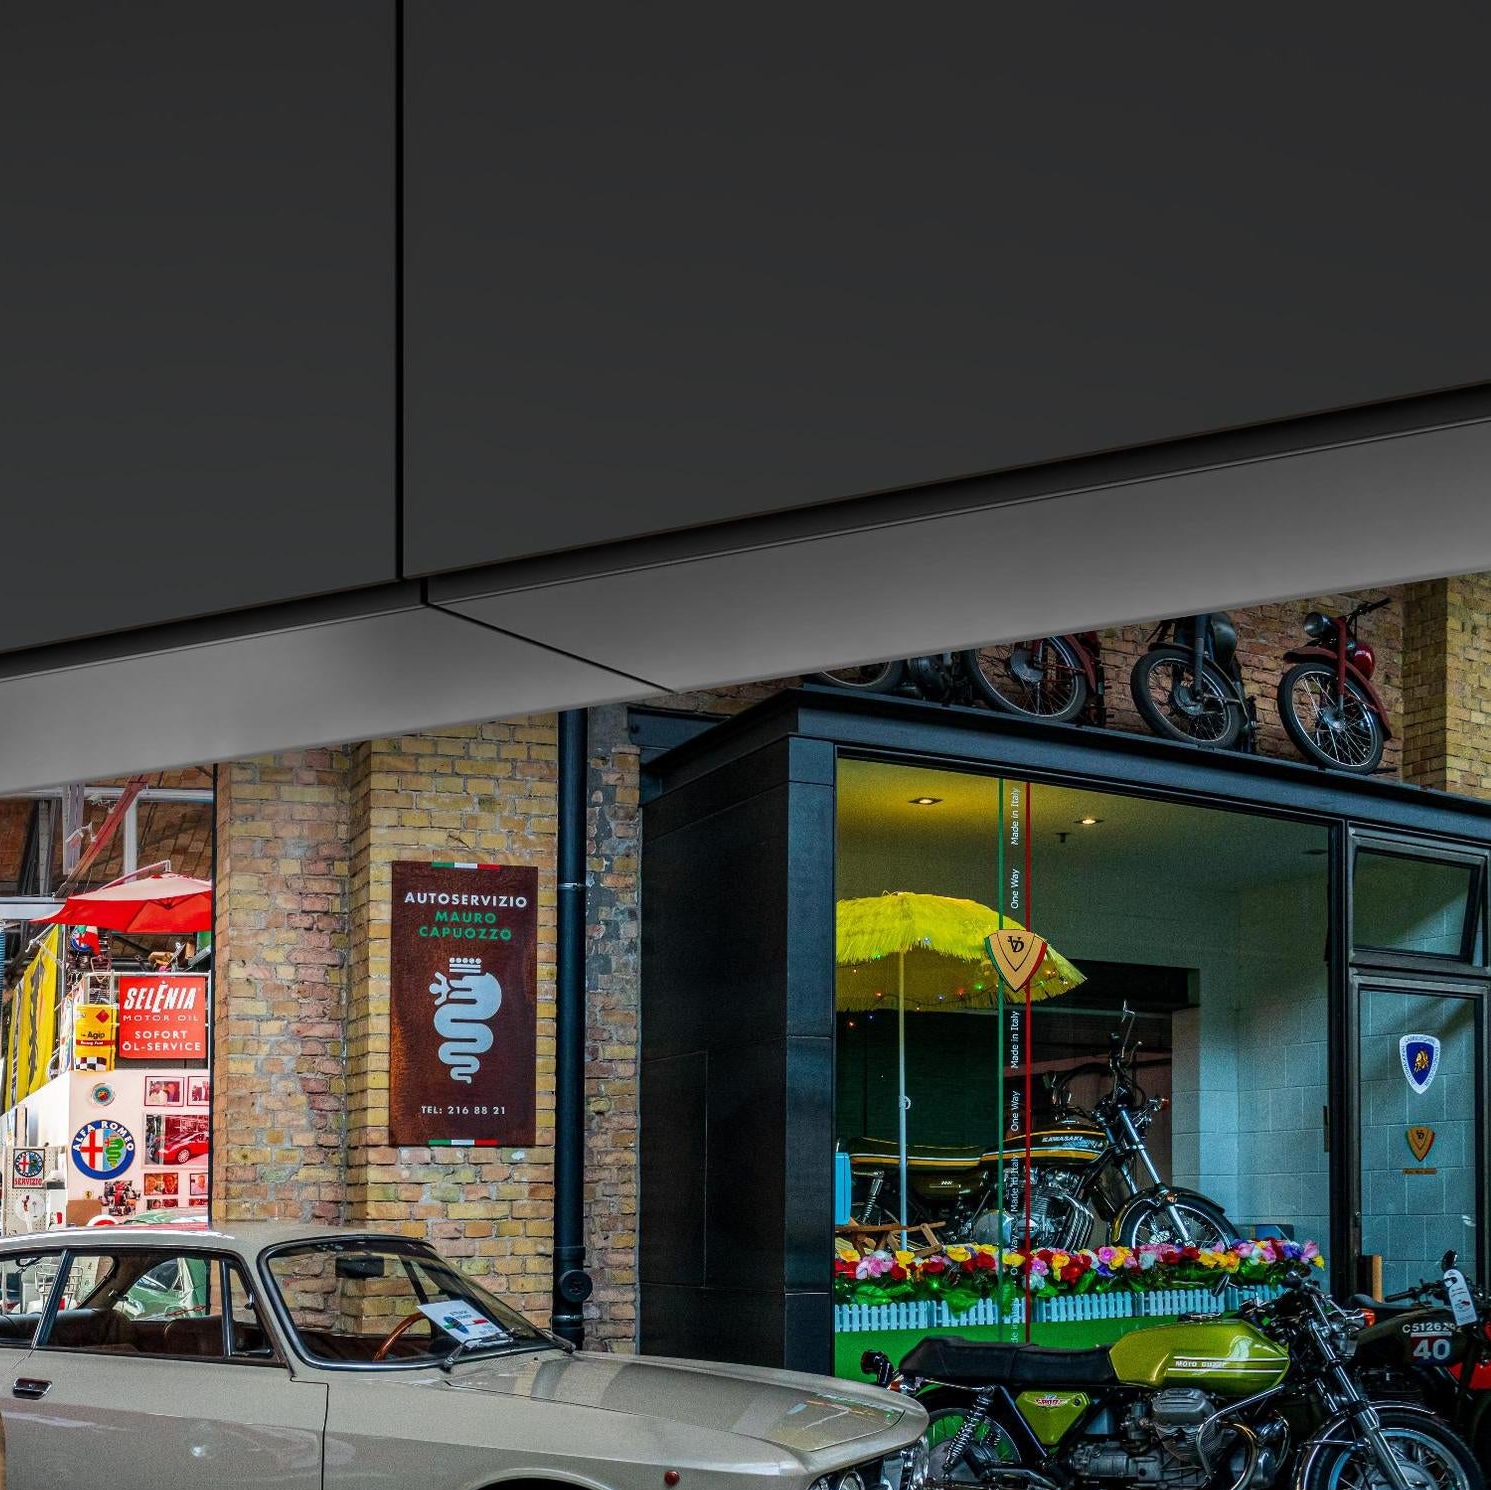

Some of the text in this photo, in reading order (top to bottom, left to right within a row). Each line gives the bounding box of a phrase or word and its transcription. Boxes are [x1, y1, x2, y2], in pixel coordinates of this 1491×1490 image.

[1011, 787, 1021, 845] Made in Italy
[1011, 868, 1021, 909] One Way
[404, 892, 527, 908] AUTOSERVIZIO
[435, 911, 496, 924] MAURO
[418, 926, 512, 940] CAPUOZZO
[135, 1030, 188, 1039] SOFORT
[1011, 1010, 1021, 1069] Made in Italy
[122, 1040, 201, 1051] ÖL-SERVICE
[421, 1105, 505, 1115] TEL: 216 88 21
[1011, 1090, 1021, 1132] One Way
[73, 1121, 134, 1152] ALFA ROMEO
[1011, 1153, 1021, 1174] Italy
[15, 1177, 42, 1186] SERVIZIO
[1011, 1187, 1019, 1213] Made
[1413, 1339, 1451, 1359] 40
[1175, 1360, 1197, 1368] MOTO
